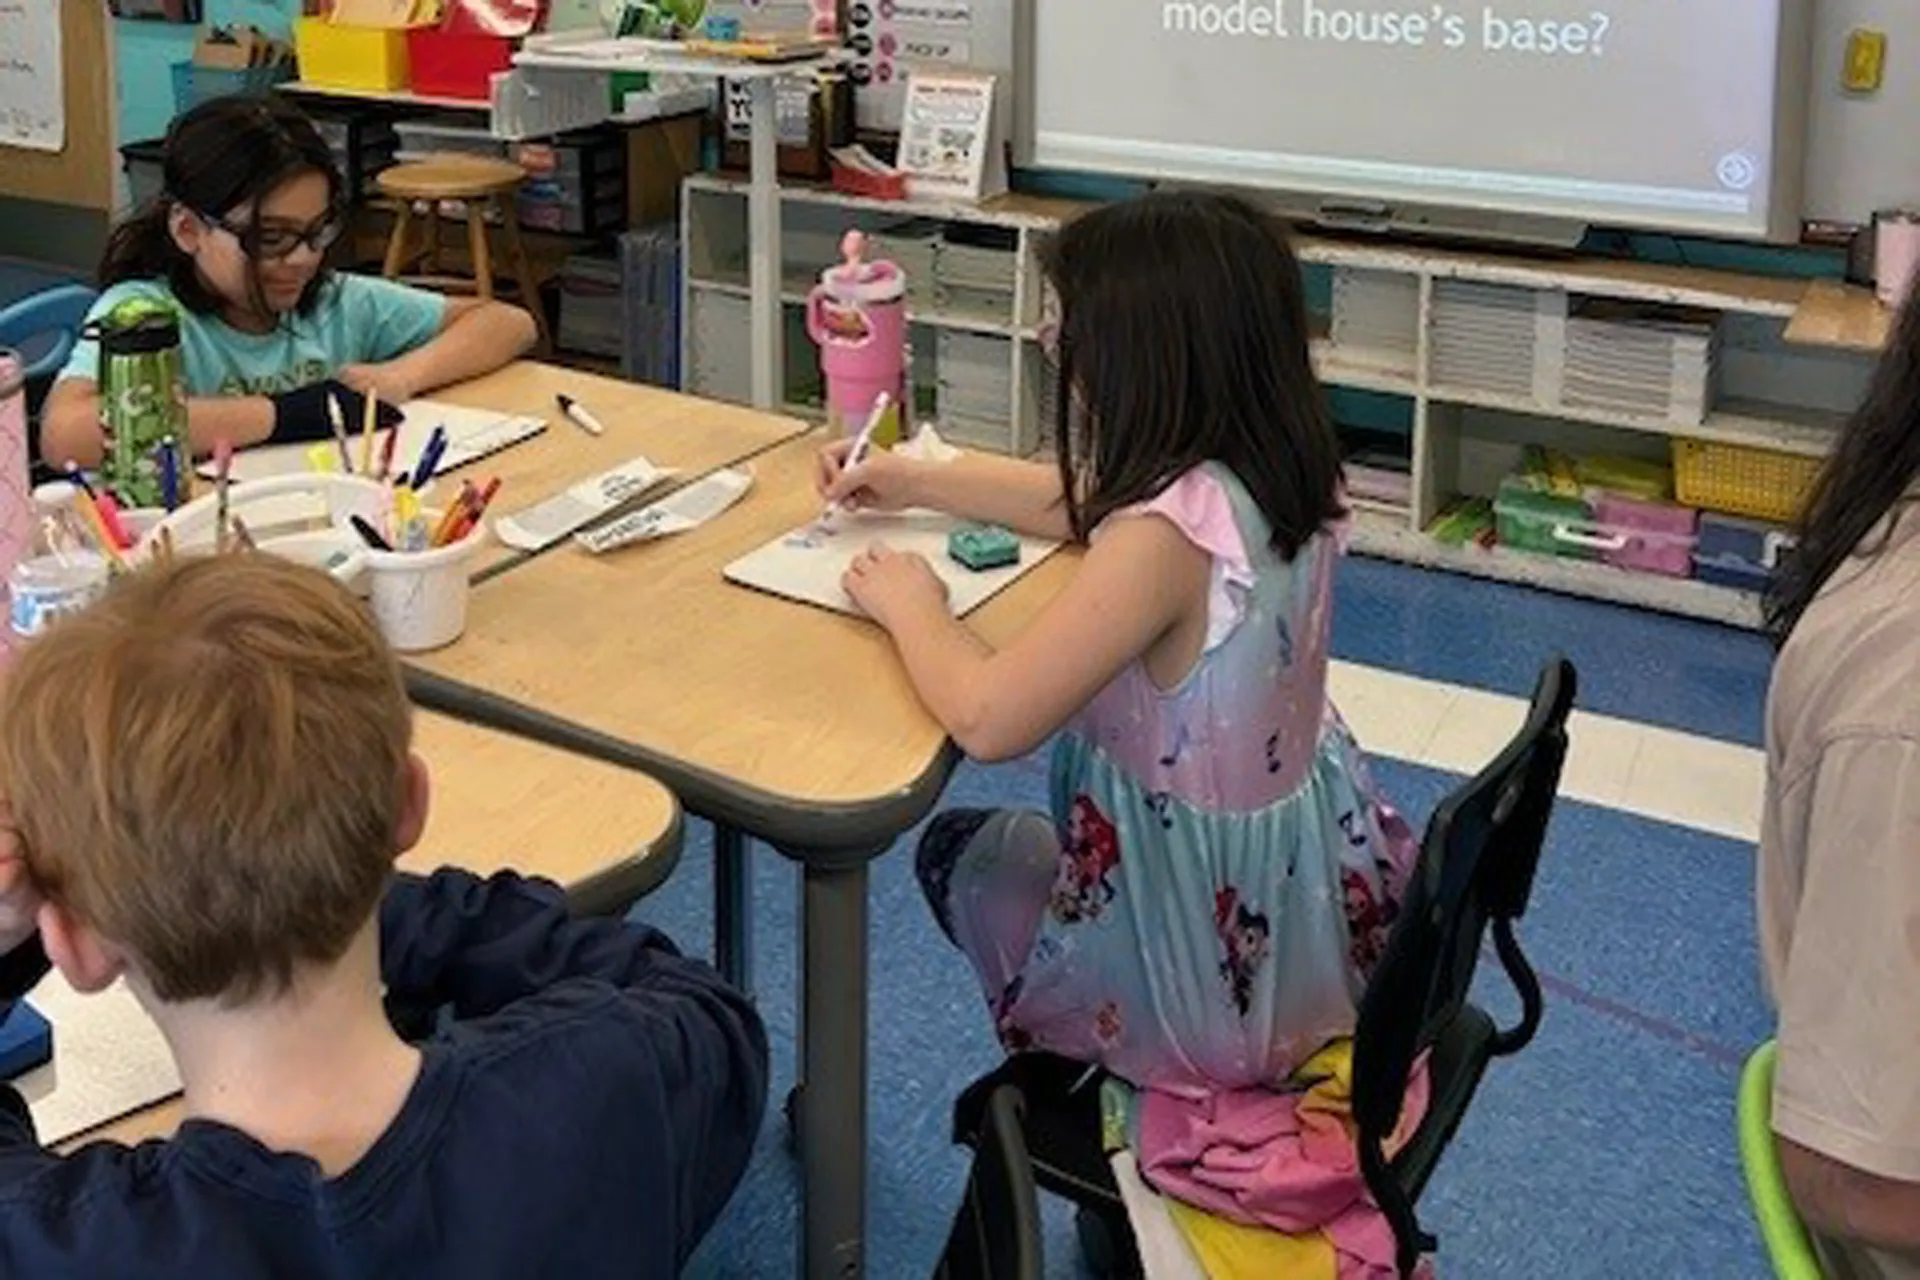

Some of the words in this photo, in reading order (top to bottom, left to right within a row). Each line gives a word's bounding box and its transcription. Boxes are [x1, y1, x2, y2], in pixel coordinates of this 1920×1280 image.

[1162, 0, 1288, 37] model
[1302, 0, 1466, 47] house’s
[1482, 6, 1609, 54] base?
